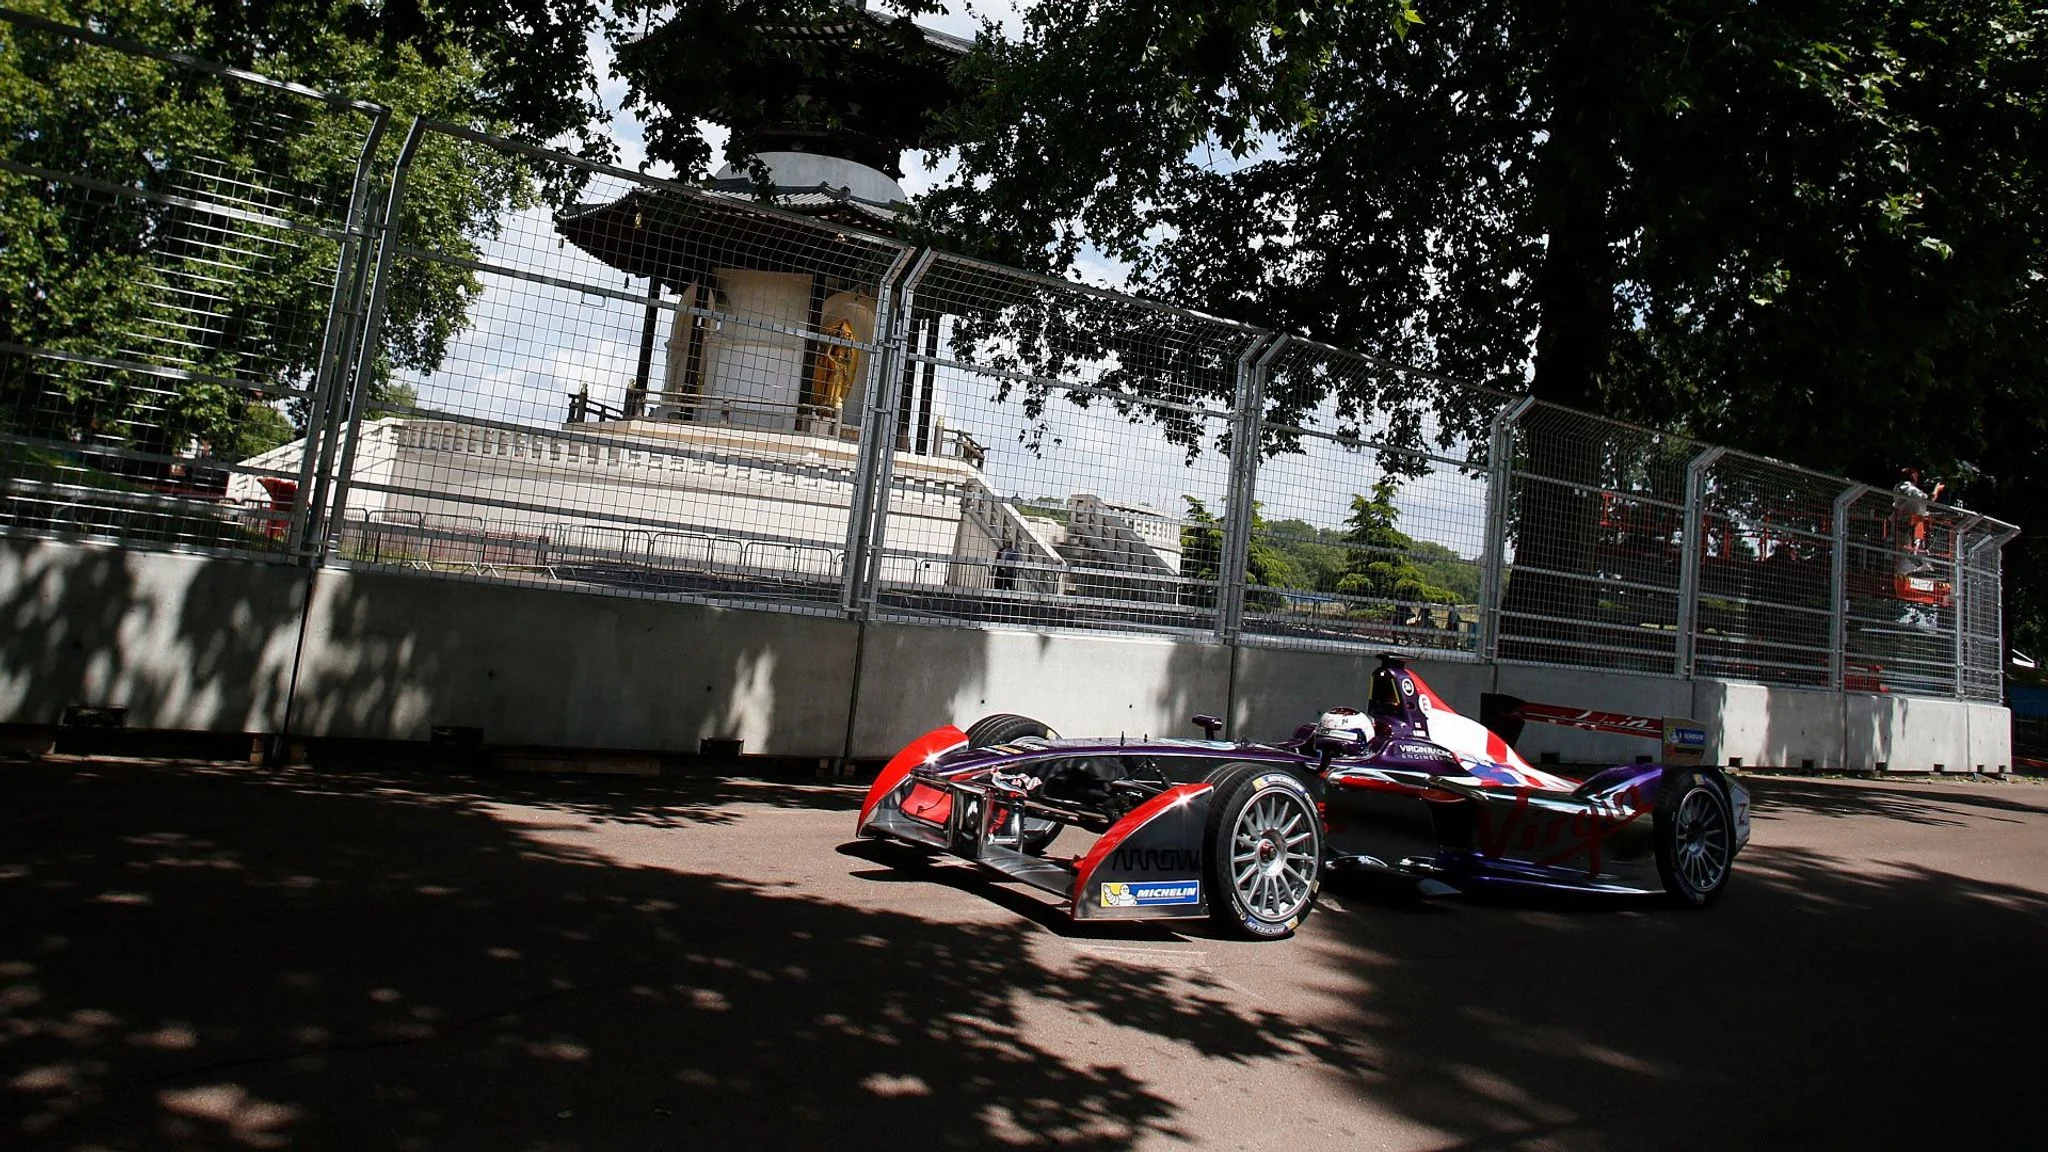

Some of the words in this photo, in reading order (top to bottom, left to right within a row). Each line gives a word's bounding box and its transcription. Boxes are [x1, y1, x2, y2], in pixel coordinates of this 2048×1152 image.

[1400, 745, 1428, 754] VIRGIN
[1475, 785, 1656, 879] Virgin
[1112, 849, 1199, 871] ARROW
[1137, 887, 1197, 898] MICHELIN
